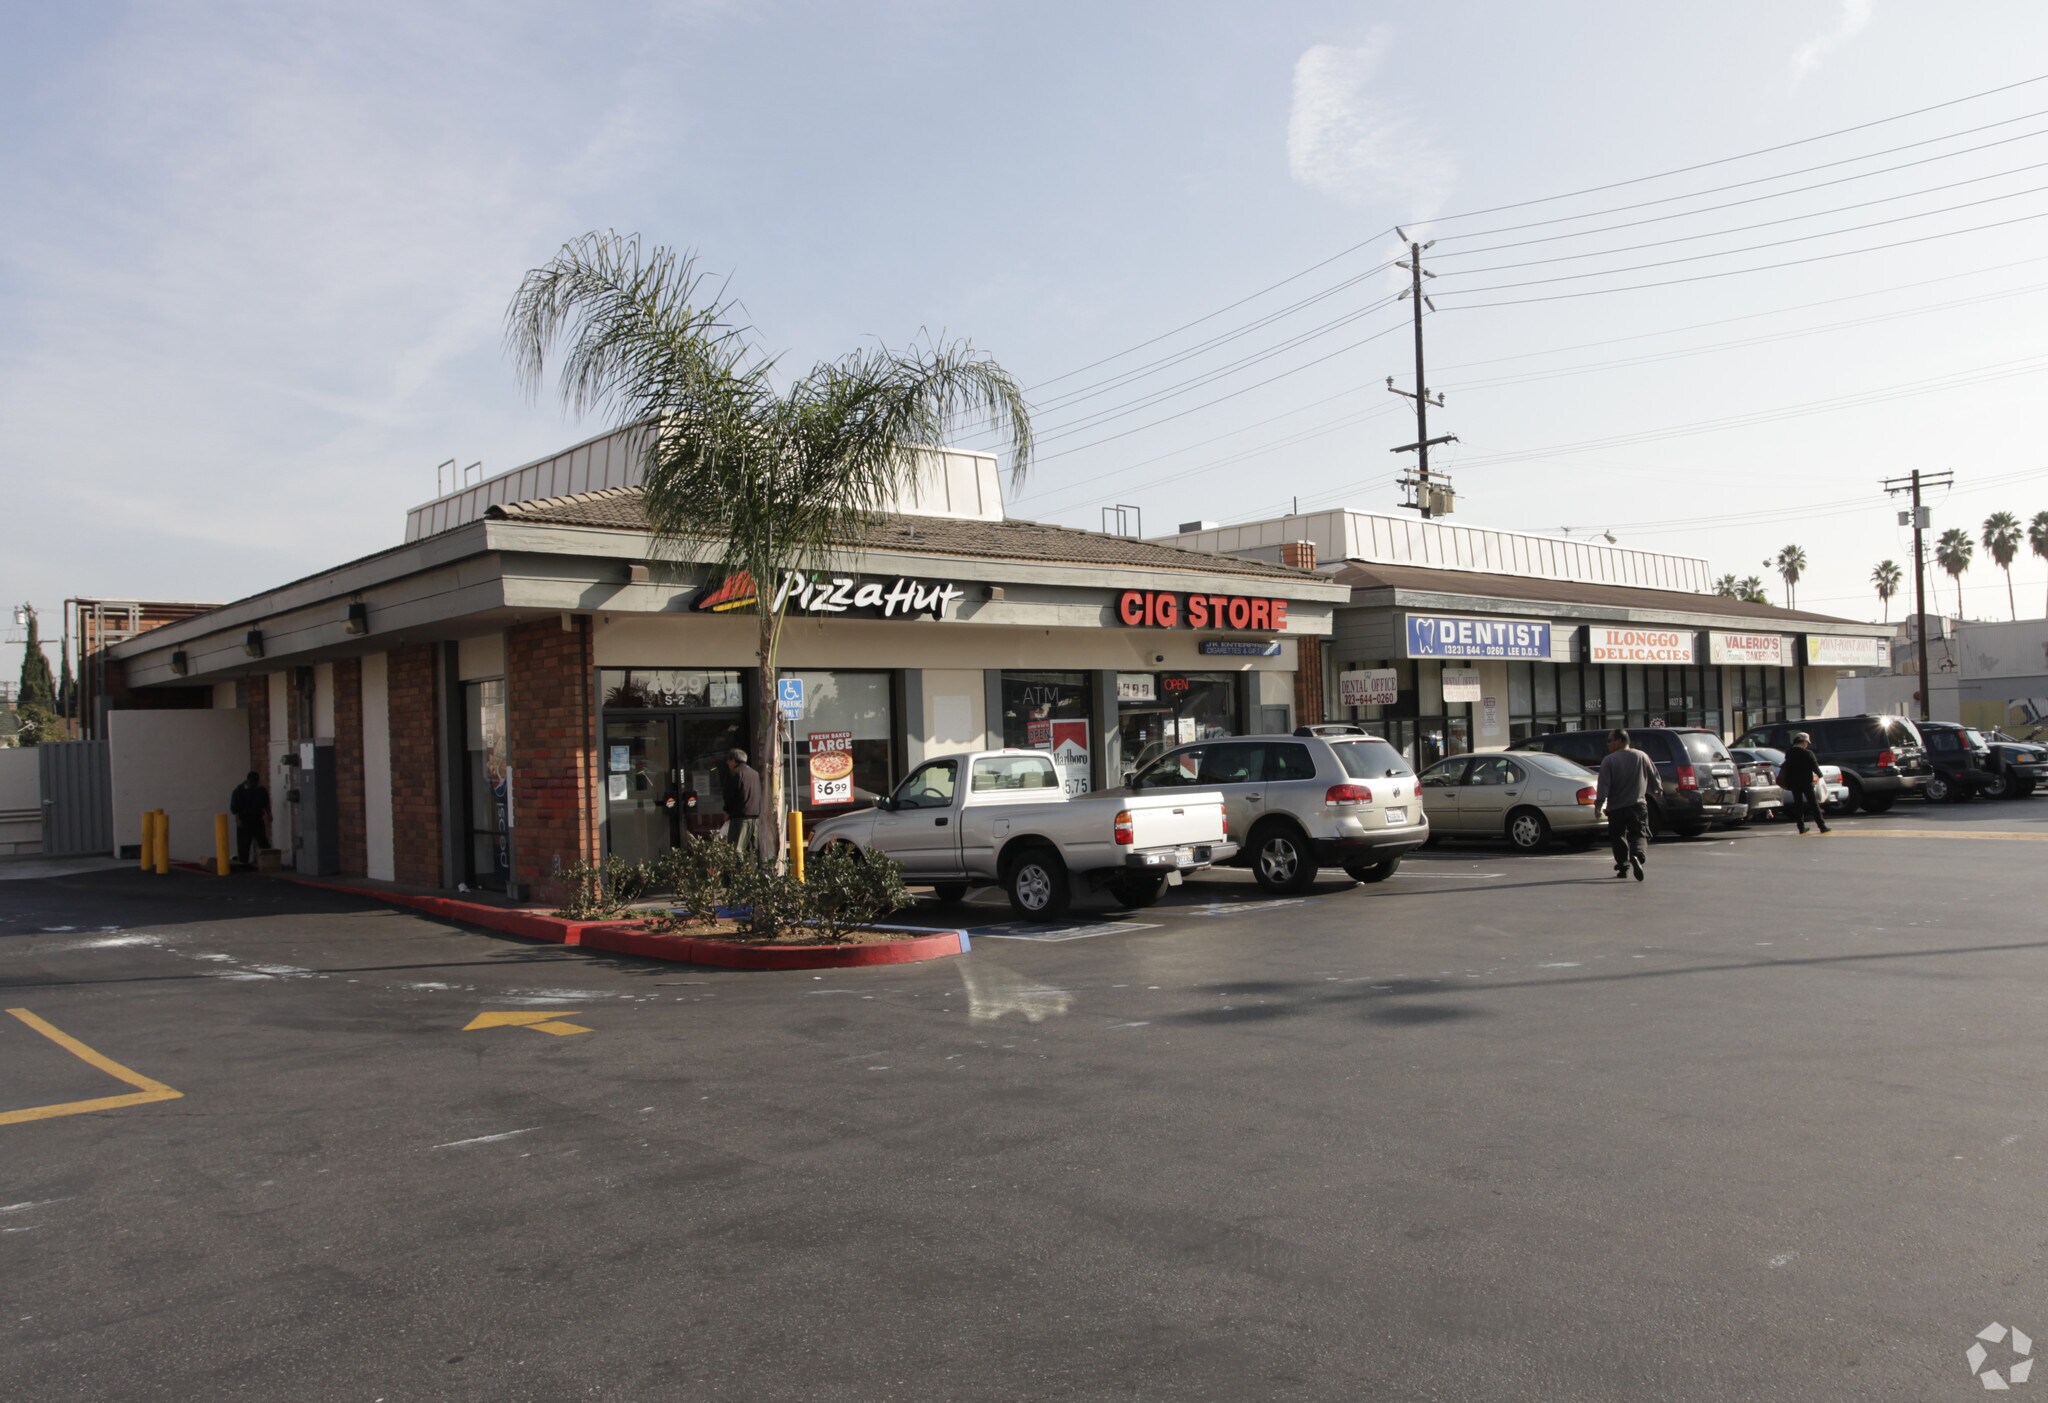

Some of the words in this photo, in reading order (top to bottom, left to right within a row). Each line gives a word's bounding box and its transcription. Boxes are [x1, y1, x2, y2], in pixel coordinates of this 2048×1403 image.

[773, 571, 883, 612] Pizza
[884, 577, 964, 618] Hut
[1120, 590, 1178, 628] CIG
[1188, 594, 1288, 630] STORE
[1439, 620, 1543, 647] DENTIST
[1606, 630, 1679, 647] ILONGGO
[1444, 645, 1464, 655] (323)
[1466, 645, 1480, 655] 644
[1486, 646, 1504, 656] 0260
[1507, 646, 1520, 656] LEE
[1725, 636, 1779, 650] VALERIO'S
[1593, 648, 1690, 660] DELICACIES
[1164, 678, 1189, 690] OPEN
[1341, 679, 1368, 694] DENTAL
[1370, 677, 1397, 692] OFFICE
[665, 695, 685, 705] S-2
[1022, 686, 1059, 705] ATM
[1344, 693, 1394, 705] 323-644-0260
[1028, 728, 1050, 741] OPEN
[809, 738, 853, 753] LARGE
[1054, 749, 1088, 766] Marlboro
[1065, 779, 1088, 794] 5.75
